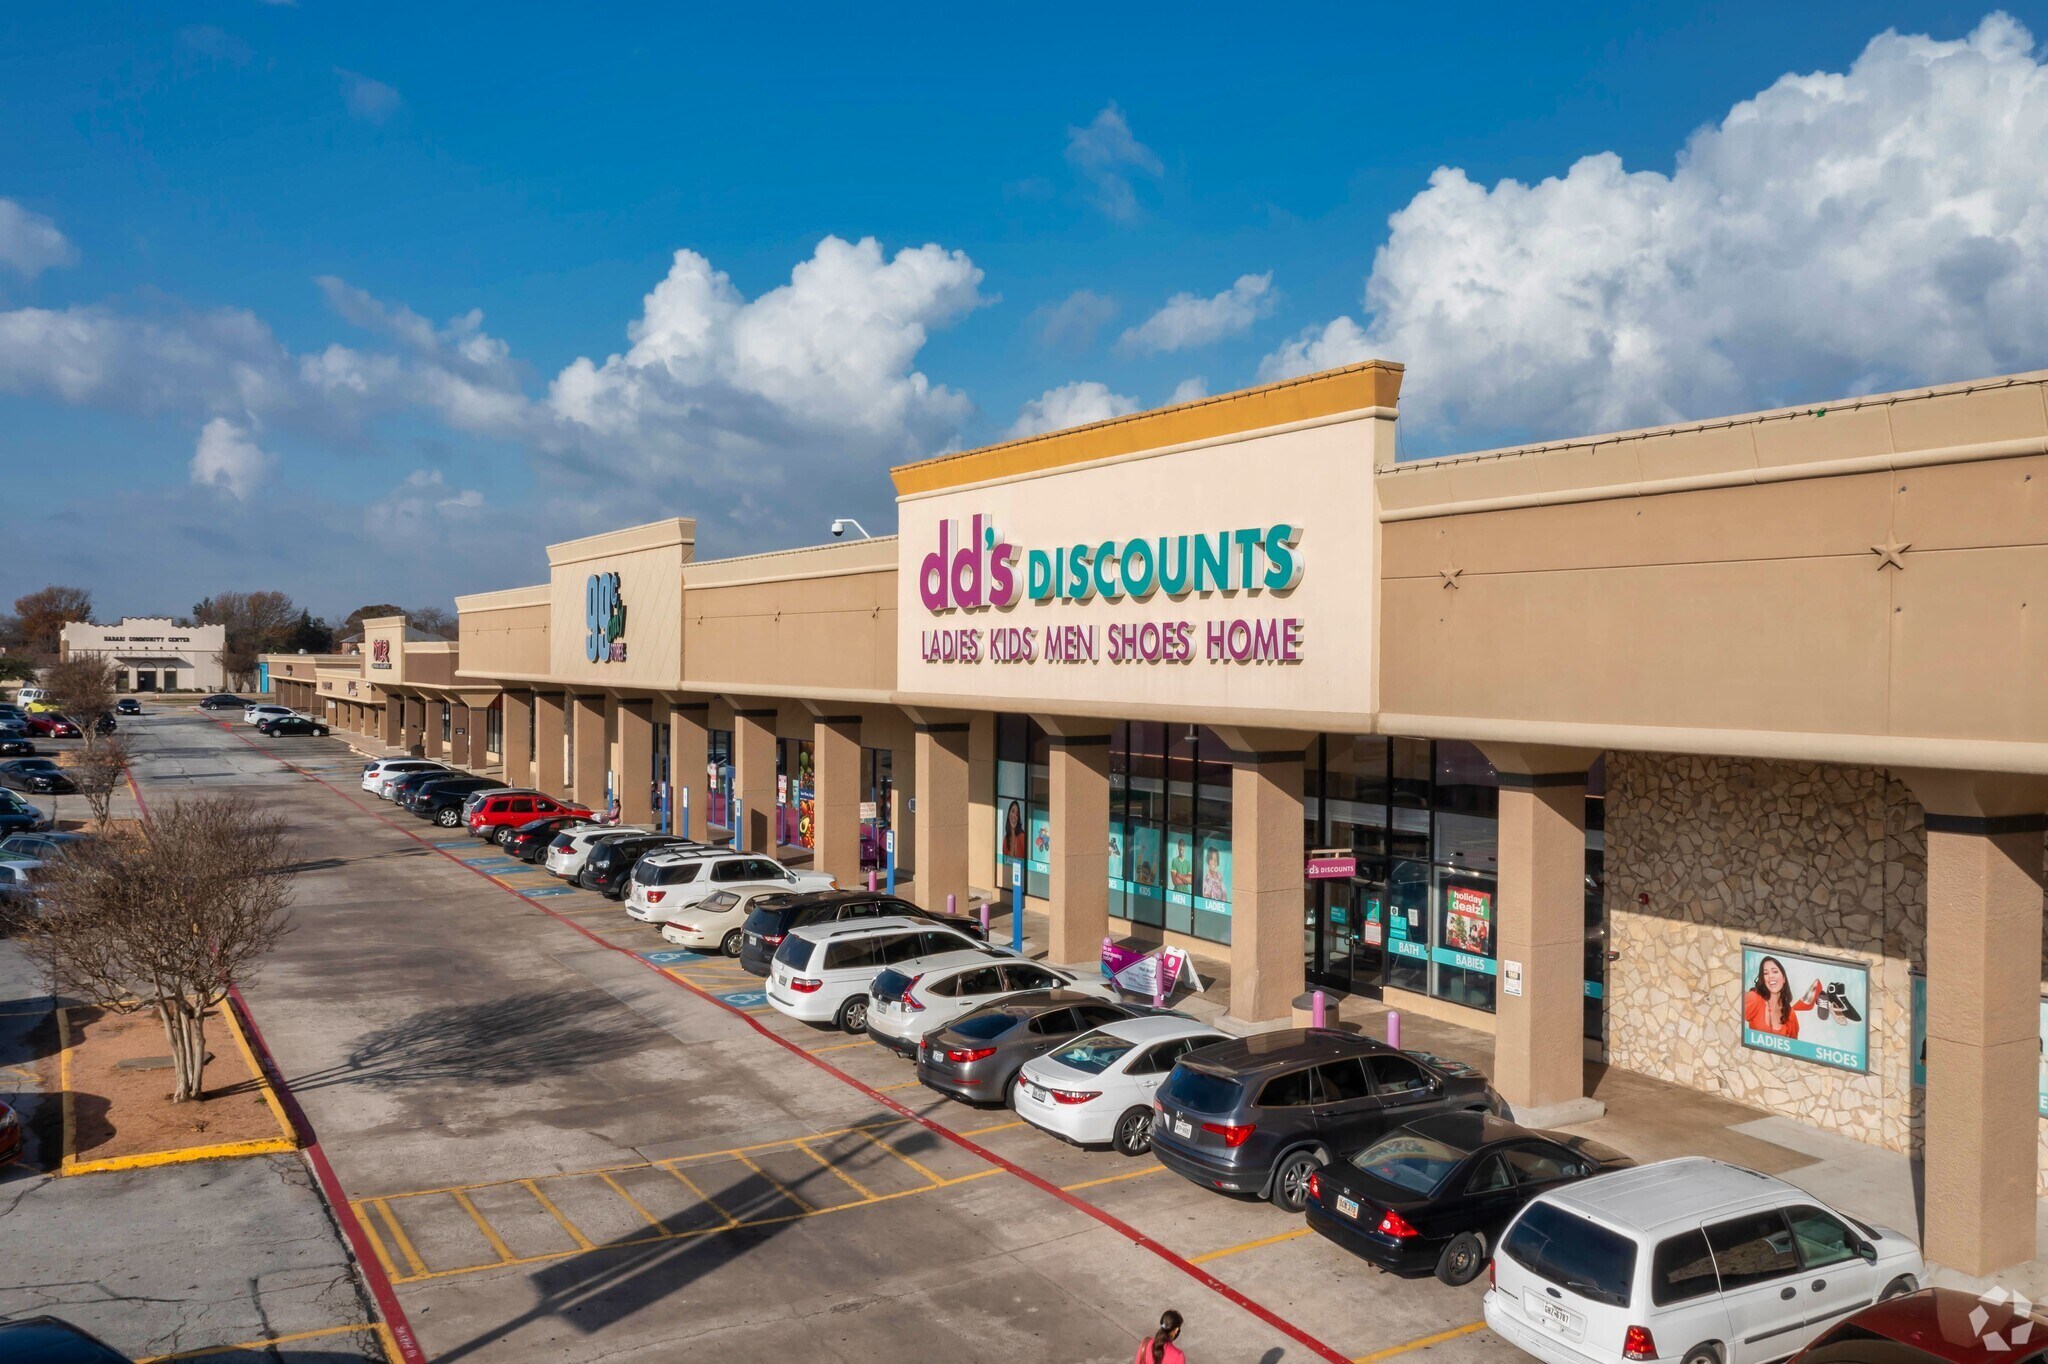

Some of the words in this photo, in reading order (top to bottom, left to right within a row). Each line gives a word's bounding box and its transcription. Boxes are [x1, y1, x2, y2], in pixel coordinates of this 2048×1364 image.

[919, 513, 1022, 612] dd's
[1028, 523, 1304, 600] DISCOUNTS
[922, 627, 983, 662] LADIES
[990, 626, 1037, 662] KIDS
[1044, 624, 1099, 662] MEN
[1107, 620, 1195, 662] SHOES
[1207, 617, 1303, 661] HOME
[1320, 865, 1354, 874] DISCOUNTS
[1139, 885, 1151, 896] KIDS
[1453, 890, 1483, 906] holiday
[1172, 893, 1186, 905] MEN
[1205, 900, 1225, 913] LADIES
[1452, 900, 1484, 916] dealz!
[1398, 941, 1419, 956] BATH
[1455, 953, 1485, 971] BABIES
[1750, 1031, 1791, 1052] LADIES
[1815, 1047, 1858, 1068] SHOES
